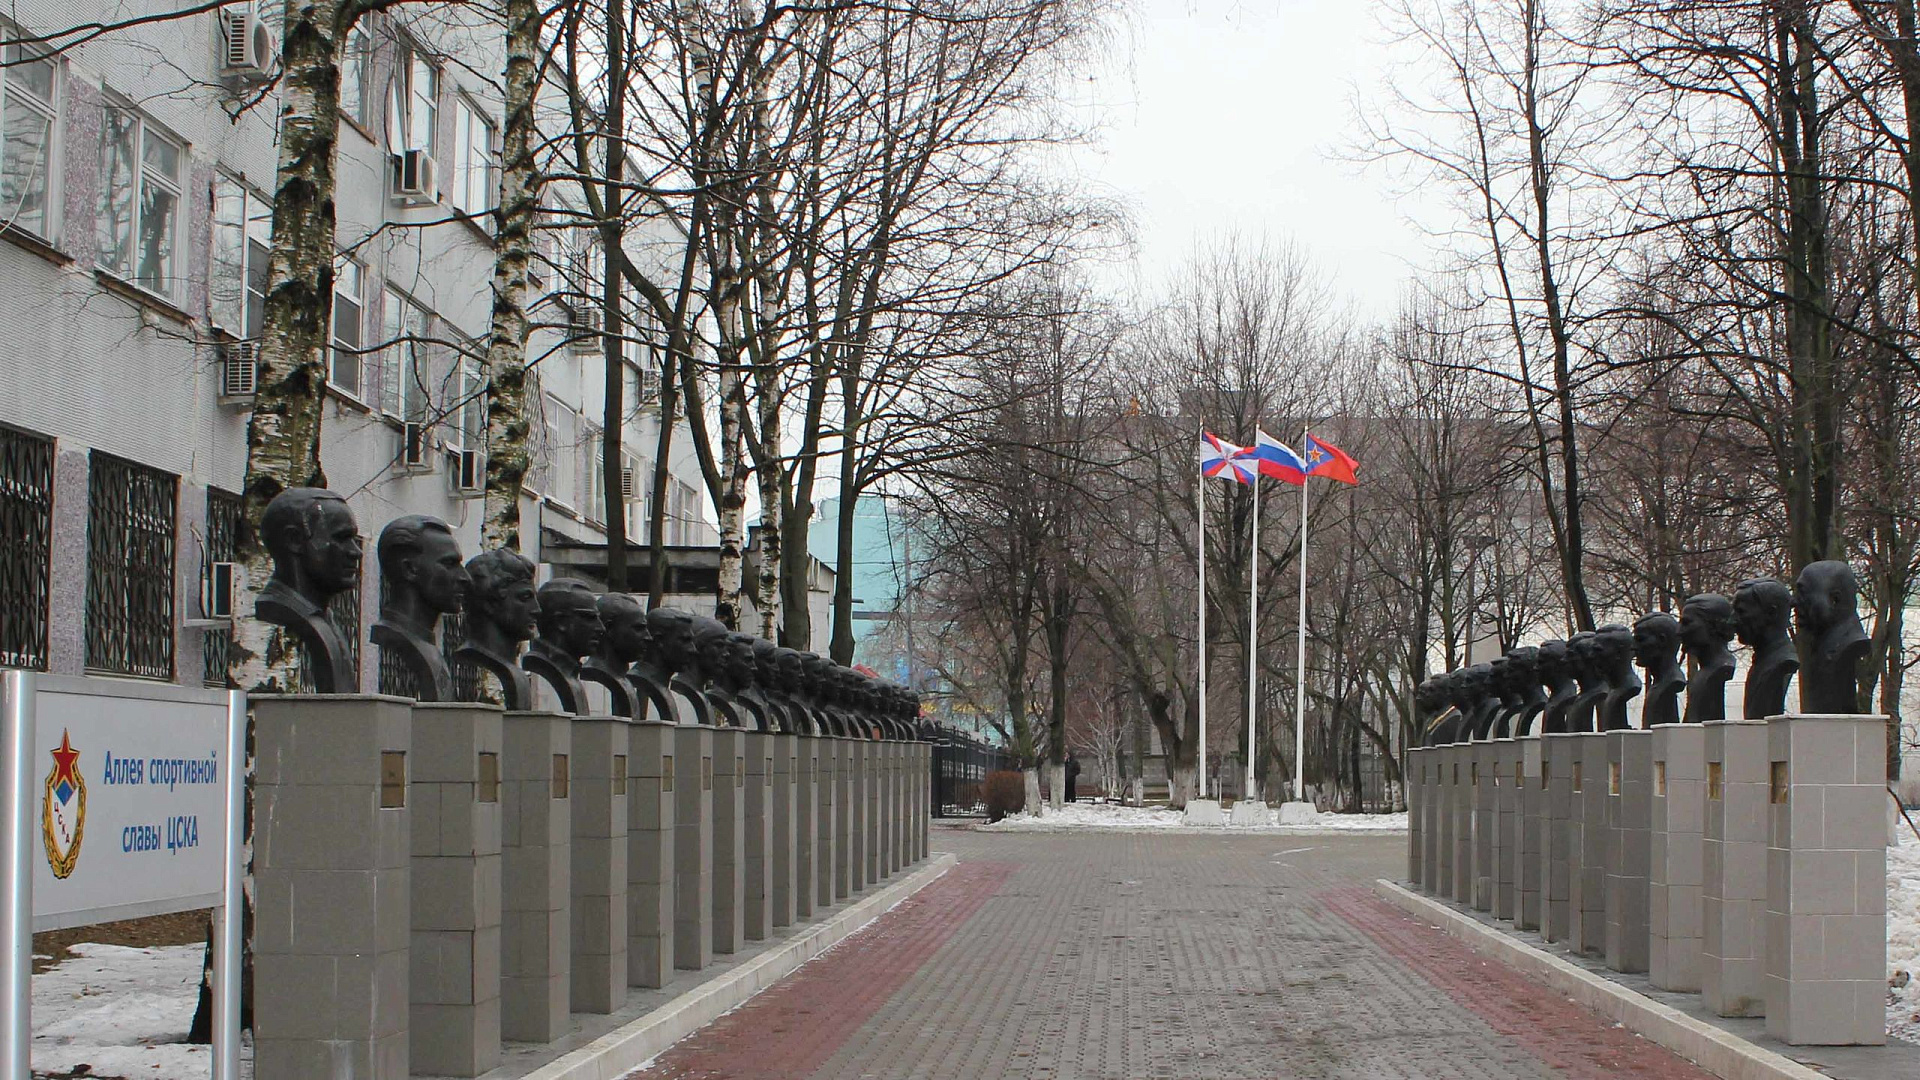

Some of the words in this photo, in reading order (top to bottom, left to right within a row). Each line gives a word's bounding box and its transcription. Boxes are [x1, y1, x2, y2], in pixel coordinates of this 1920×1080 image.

[104, 751, 143, 784] Аллея
[149, 750, 217, 792] спортивной
[54, 802, 70, 843] ЦСКА
[122, 824, 161, 853] славы
[167, 815, 198, 855] ЦСКА
